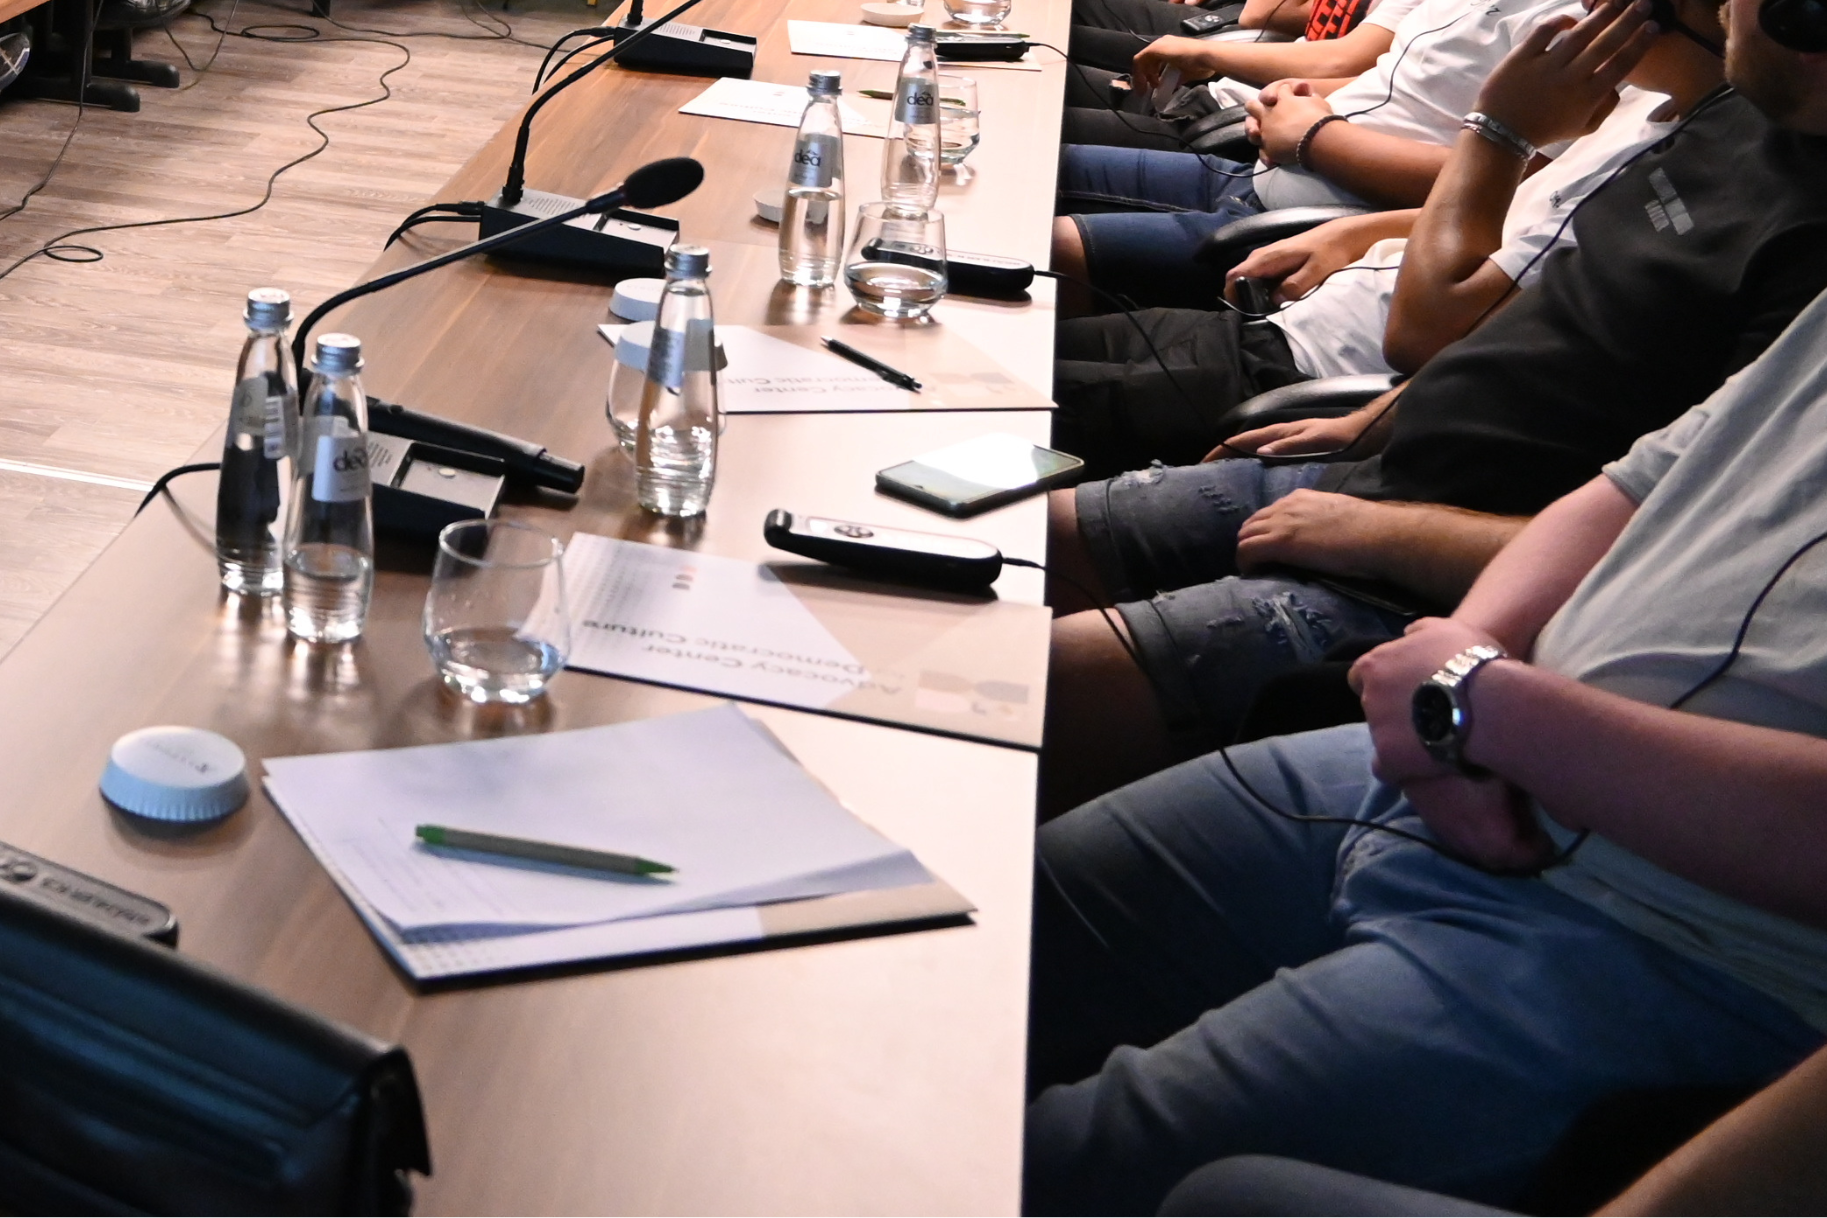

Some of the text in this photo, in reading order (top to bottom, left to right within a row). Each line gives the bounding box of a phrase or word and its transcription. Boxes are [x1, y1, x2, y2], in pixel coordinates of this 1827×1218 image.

[581, 618, 687, 646] Culture
[640, 642, 902, 694] Advocacy Center
[696, 638, 866, 676] Democratic
